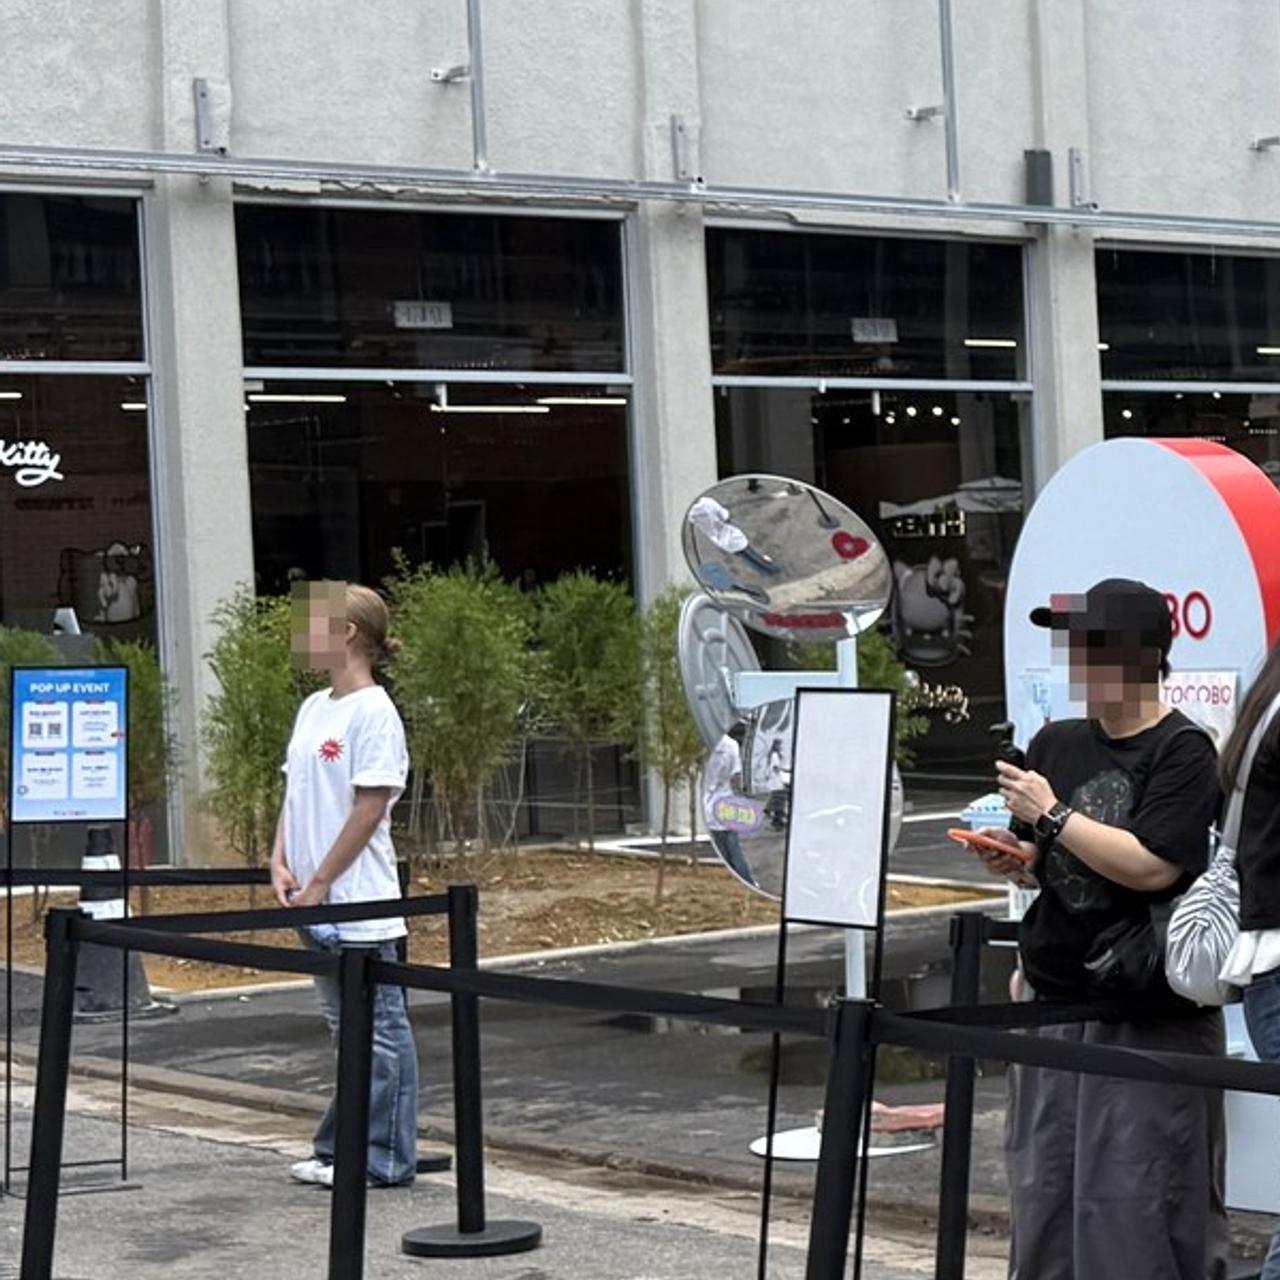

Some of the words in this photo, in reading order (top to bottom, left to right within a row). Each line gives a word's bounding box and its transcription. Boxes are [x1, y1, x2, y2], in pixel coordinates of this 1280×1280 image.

[30, 682, 54, 693] POP
[56, 683, 72, 693] UP
[73, 682, 110, 693] EVENT
[1163, 684, 1232, 705] TOCOBO
